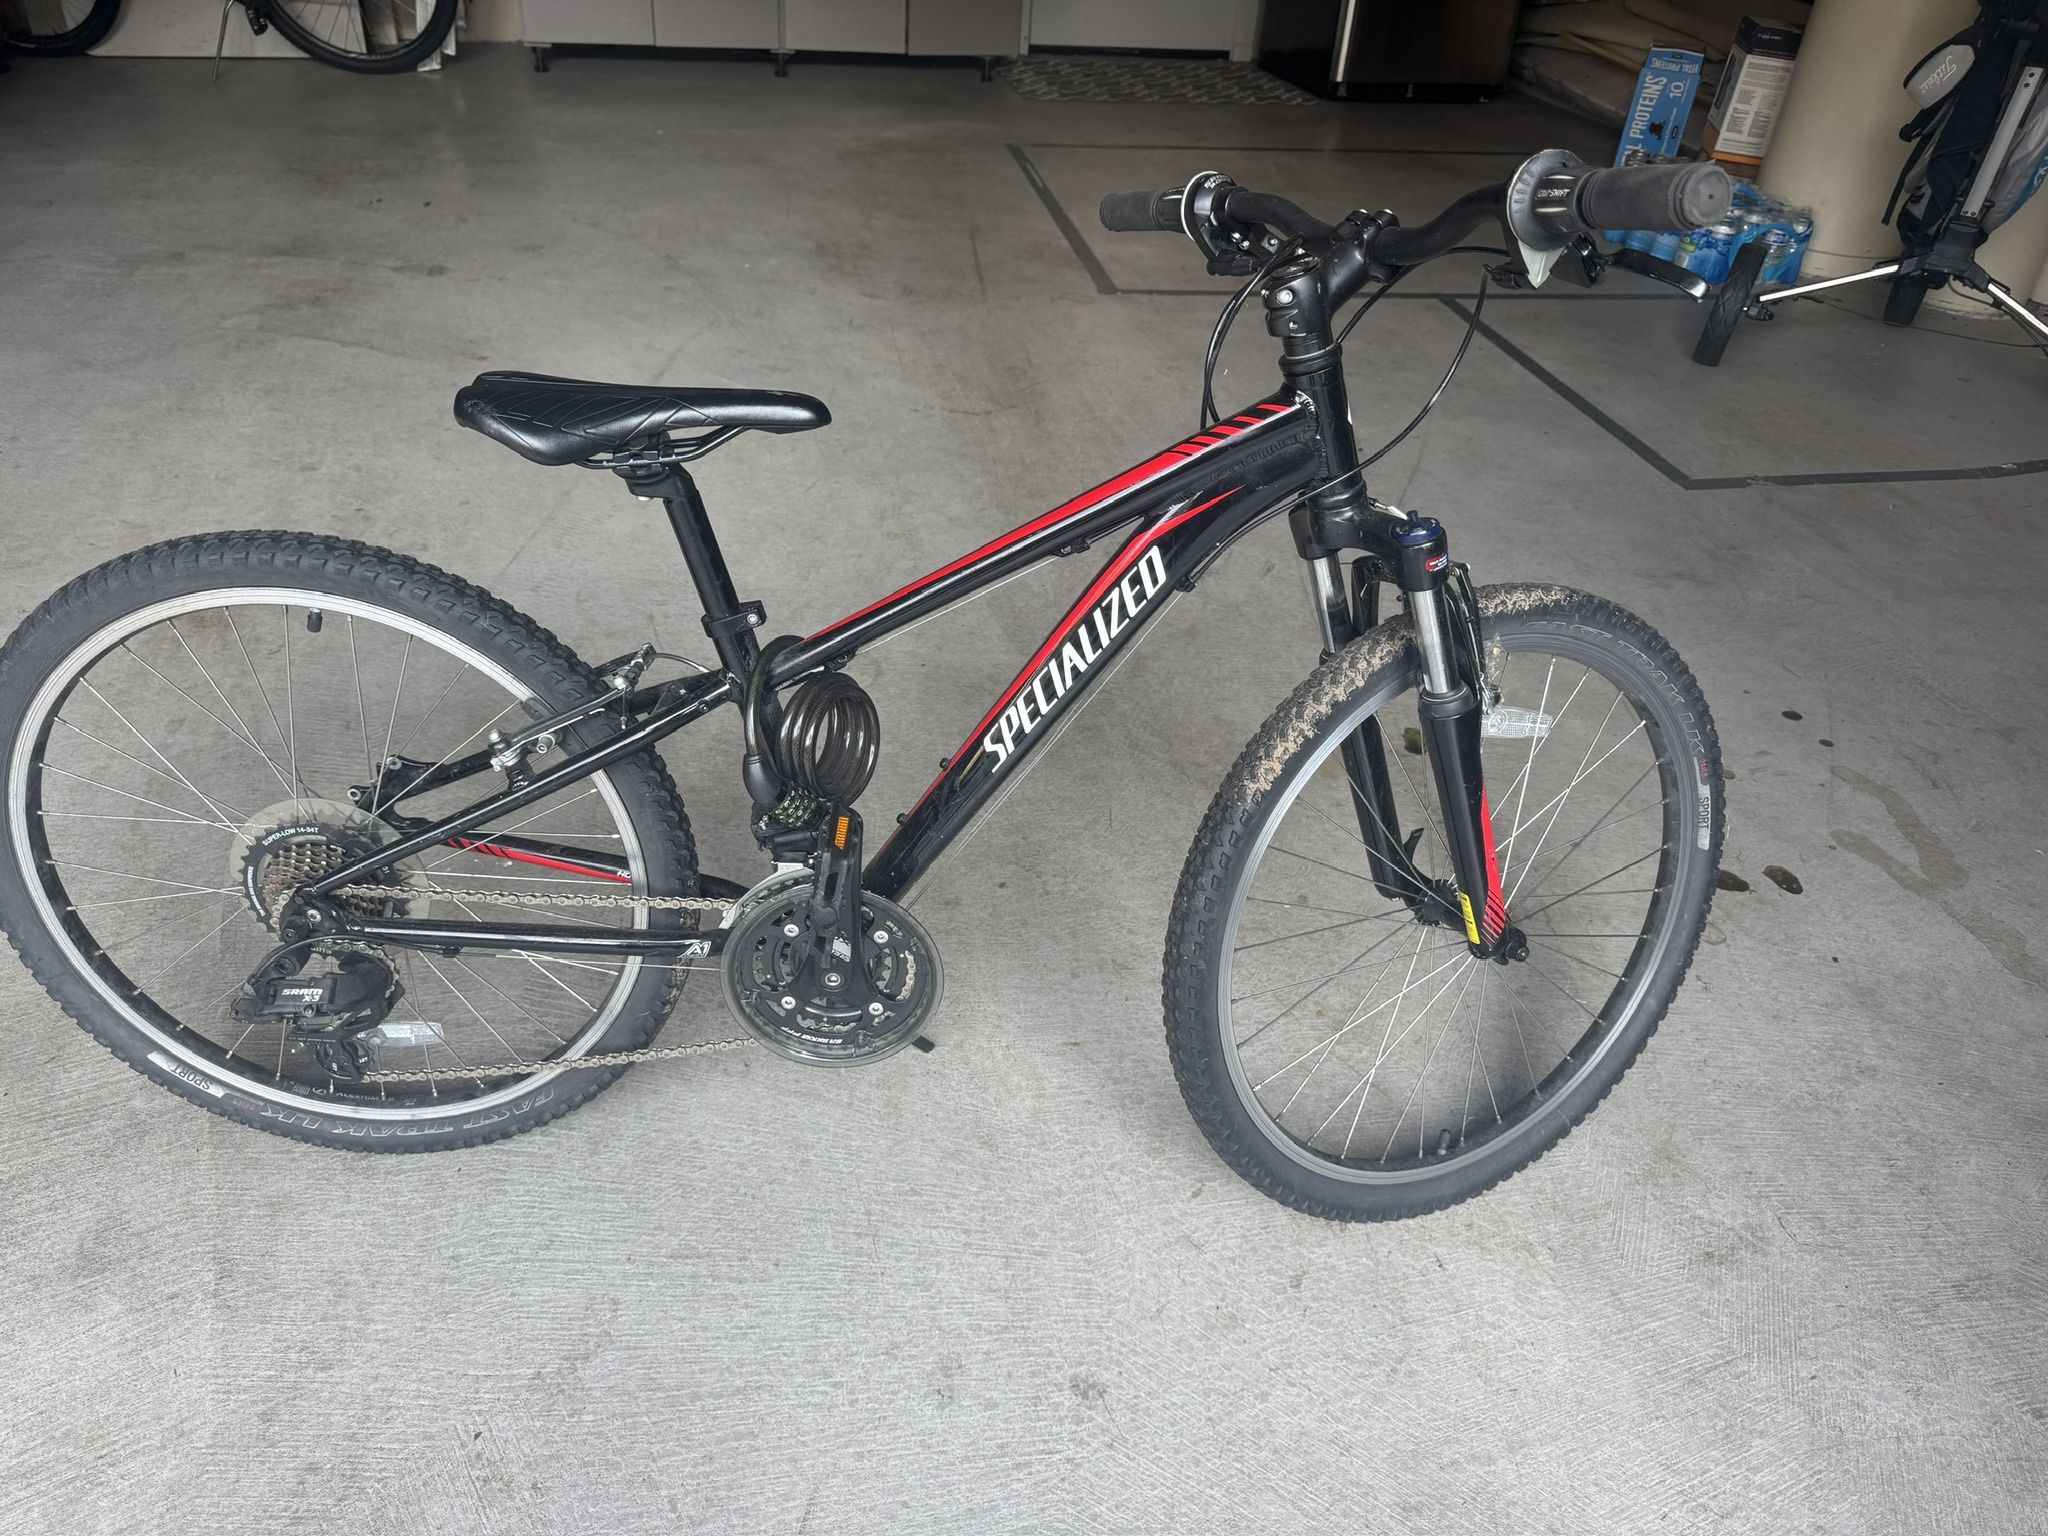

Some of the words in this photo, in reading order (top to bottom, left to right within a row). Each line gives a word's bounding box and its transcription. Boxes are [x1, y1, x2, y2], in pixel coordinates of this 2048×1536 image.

[1629, 75, 1668, 139] PROTEINS
[983, 545, 1167, 773] SPECIALIZED
[1698, 796, 1710, 830] SPORT
[261, 827, 296, 847] SUPER-LOW
[281, 988, 324, 996] SRAM
[169, 1063, 213, 1091] SPORT
[463, 1088, 554, 1129] FAST
